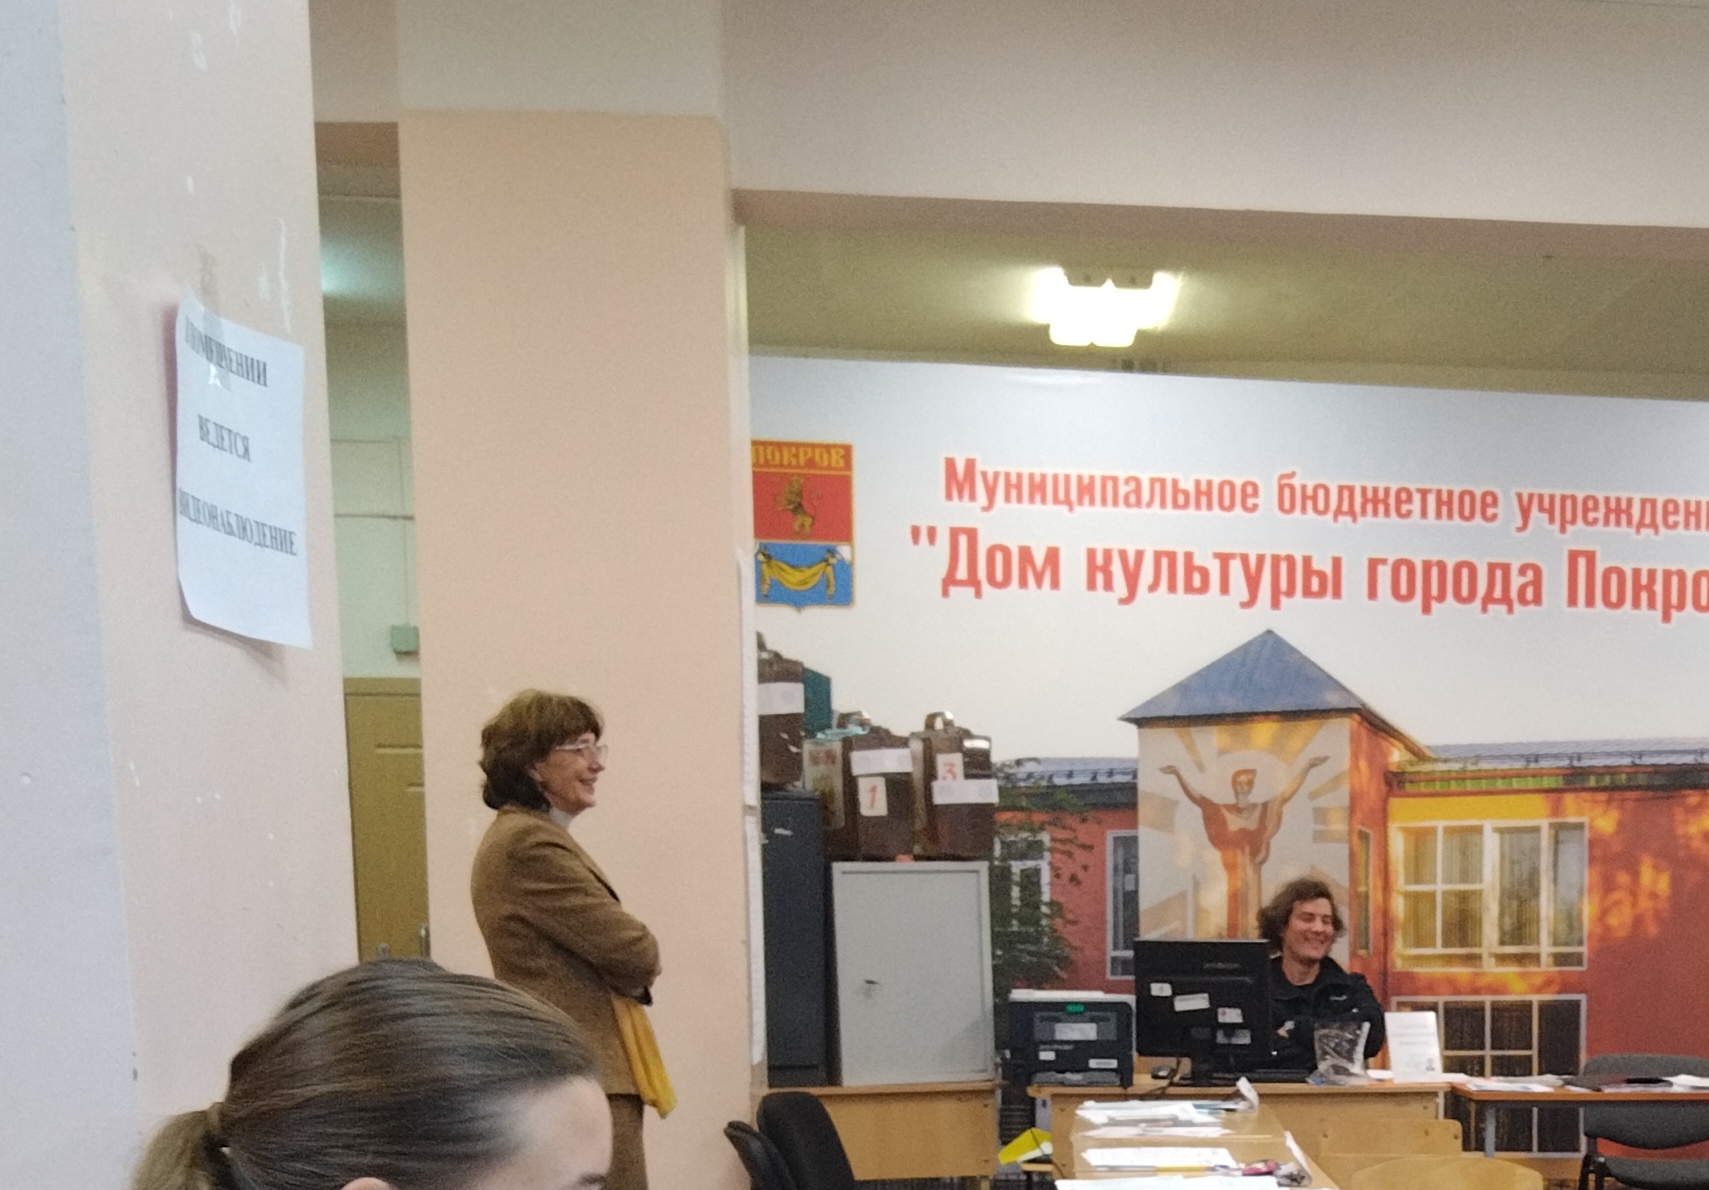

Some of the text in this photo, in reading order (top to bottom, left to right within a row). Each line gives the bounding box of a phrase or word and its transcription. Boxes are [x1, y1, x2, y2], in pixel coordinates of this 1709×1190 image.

[197, 413, 252, 462] ВЕДЕТСЯ
[751, 445, 845, 468] ПОКРОВ
[944, 457, 1260, 513] Муниципальное
[1277, 472, 1499, 523] бюджетное
[1086, 547, 1343, 610] культуры
[1367, 557, 1543, 615] города
